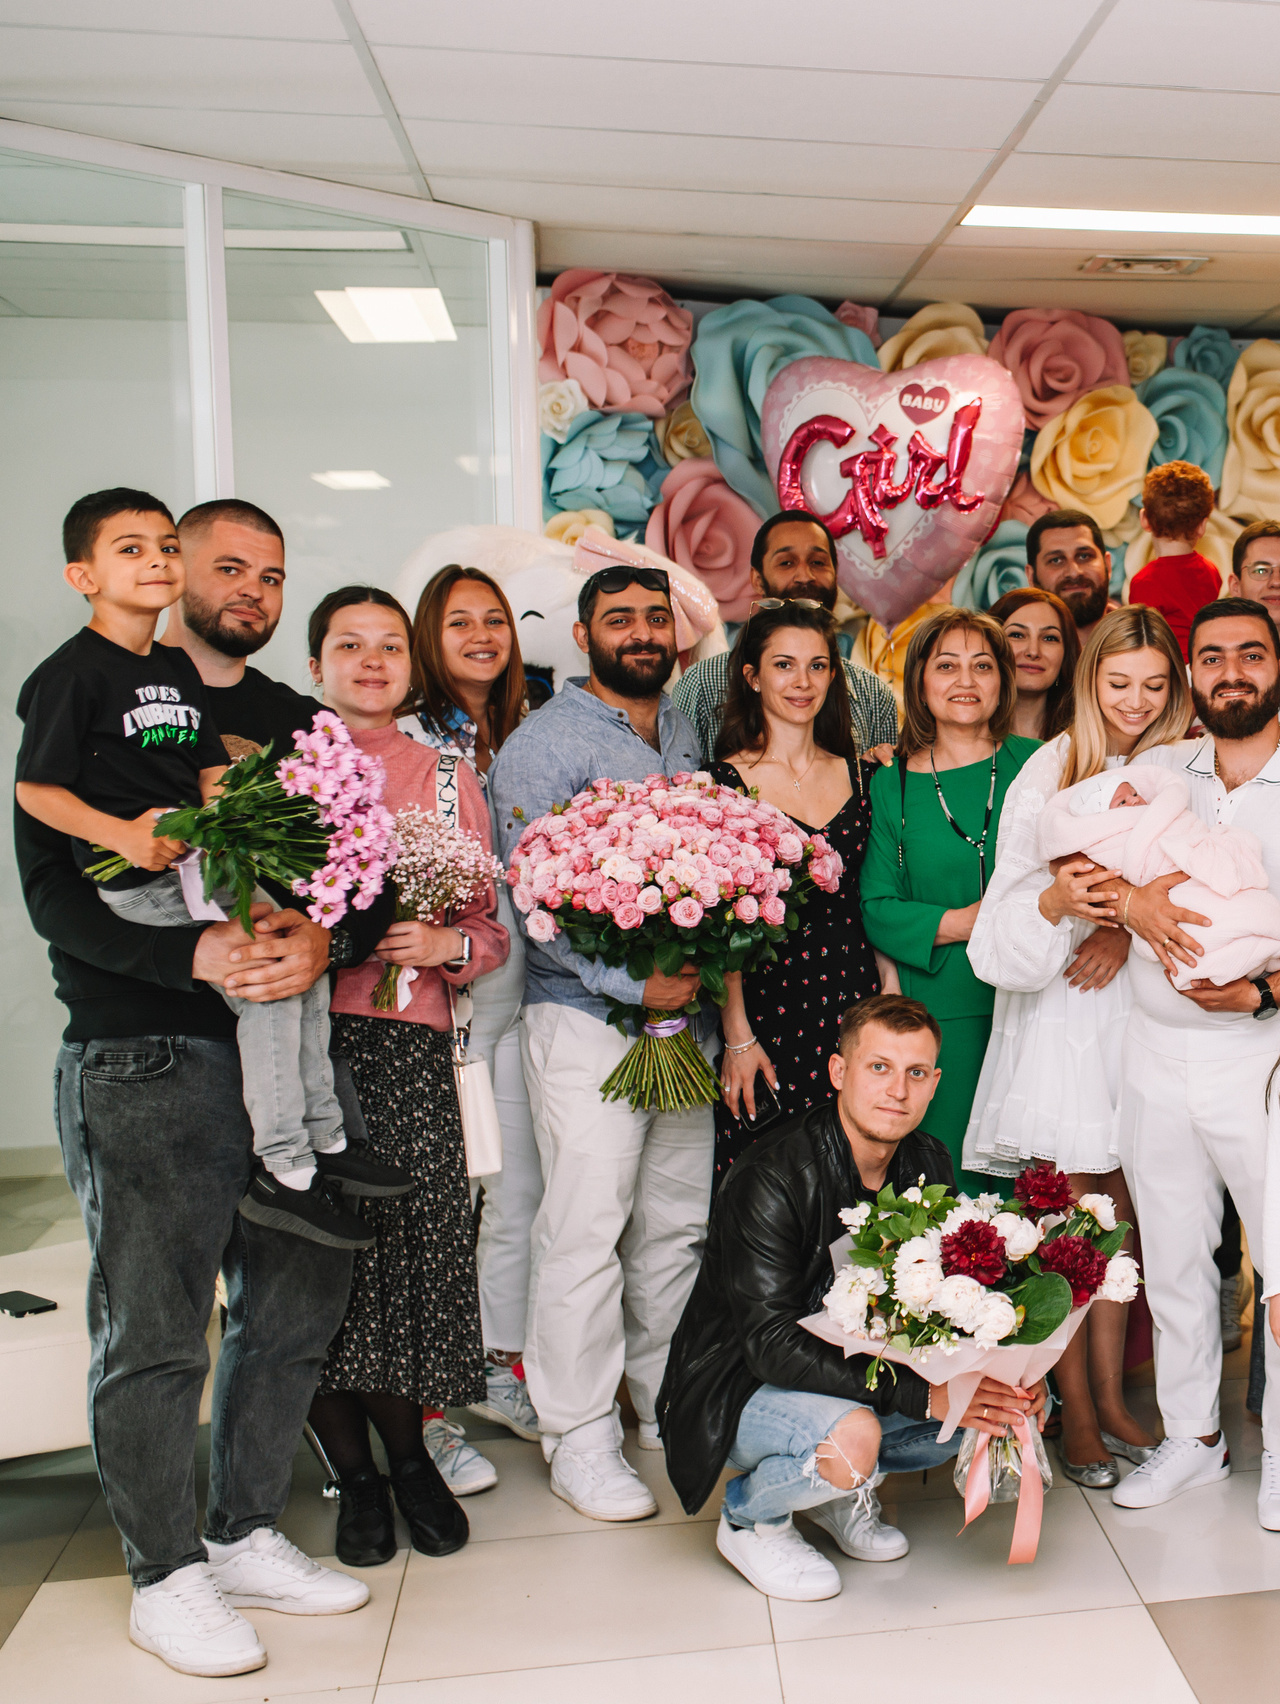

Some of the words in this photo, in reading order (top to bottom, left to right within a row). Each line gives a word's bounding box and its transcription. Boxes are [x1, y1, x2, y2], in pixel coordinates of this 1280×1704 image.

[901, 393, 945, 413] BABY
[778, 397, 985, 559] Girl
[135, 685, 181, 703] TOES
